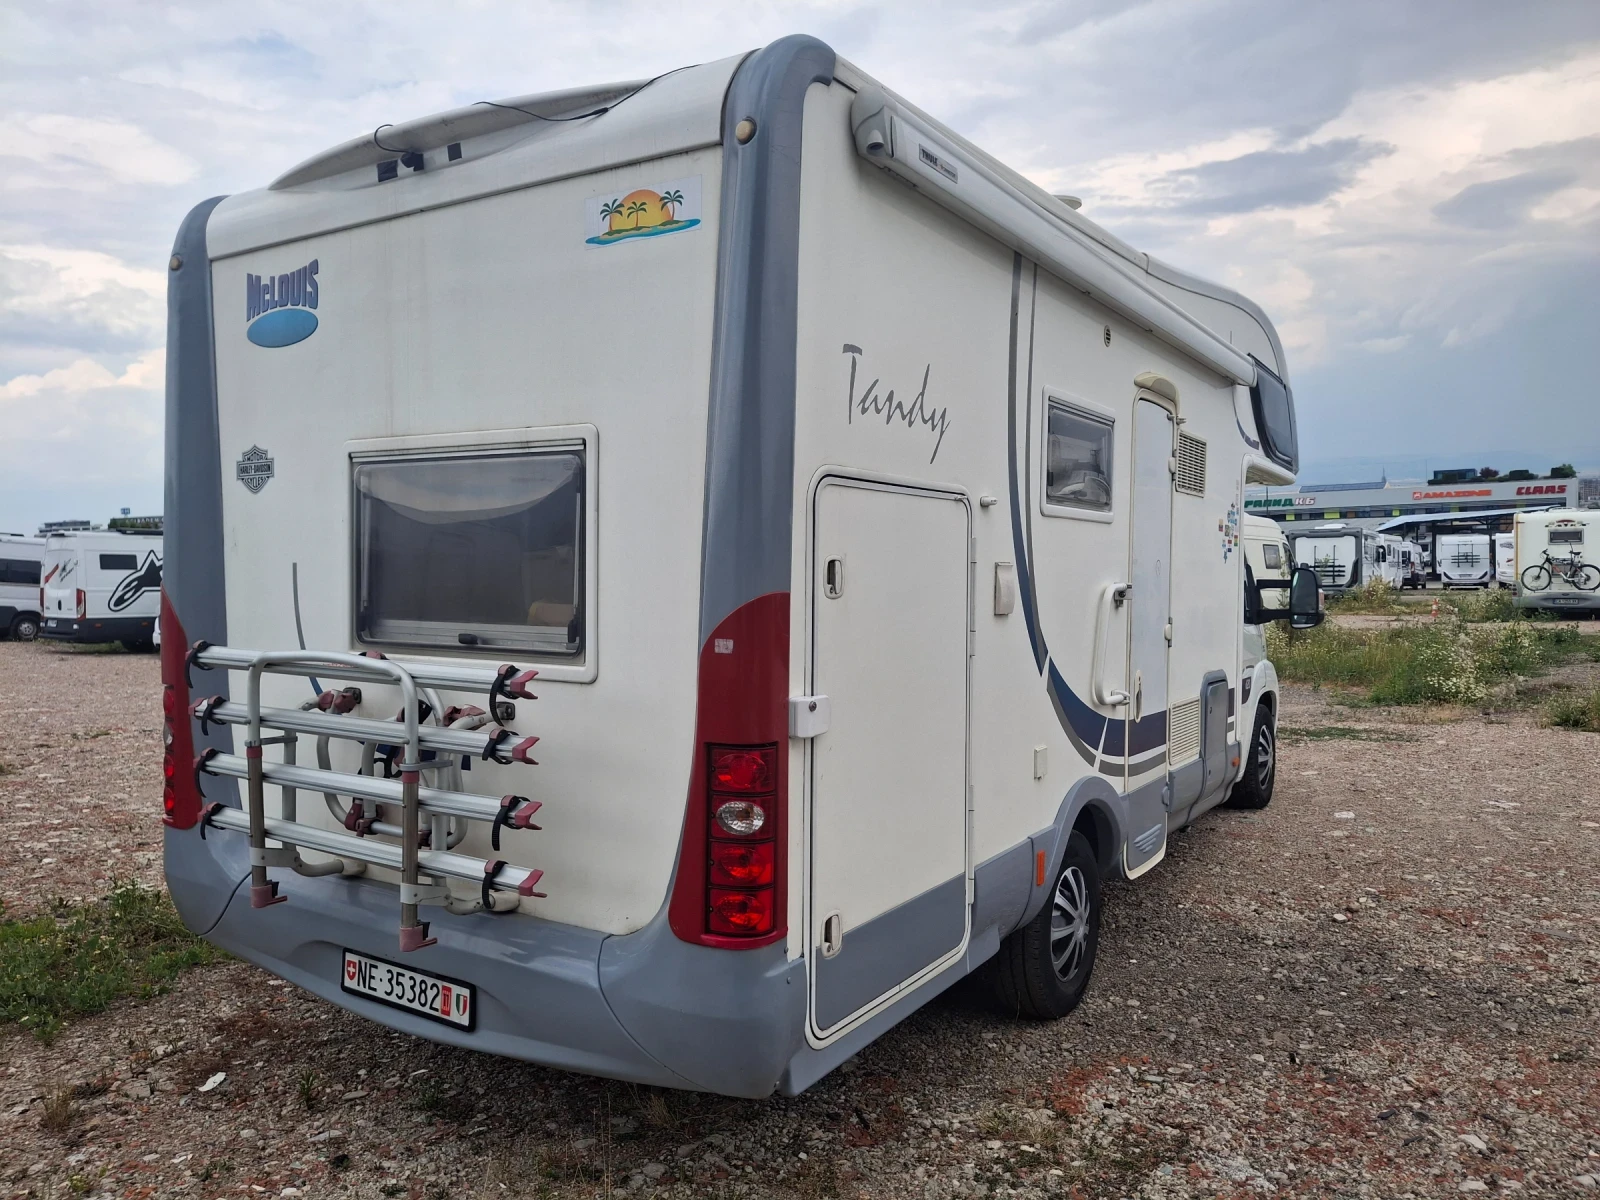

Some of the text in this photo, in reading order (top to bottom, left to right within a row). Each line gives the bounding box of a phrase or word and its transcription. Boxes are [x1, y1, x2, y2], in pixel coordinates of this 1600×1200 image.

[842, 343, 951, 465] Tandy
[1422, 489, 1492, 499] AMAZONE
[1516, 485, 1567, 496] CLAAS
